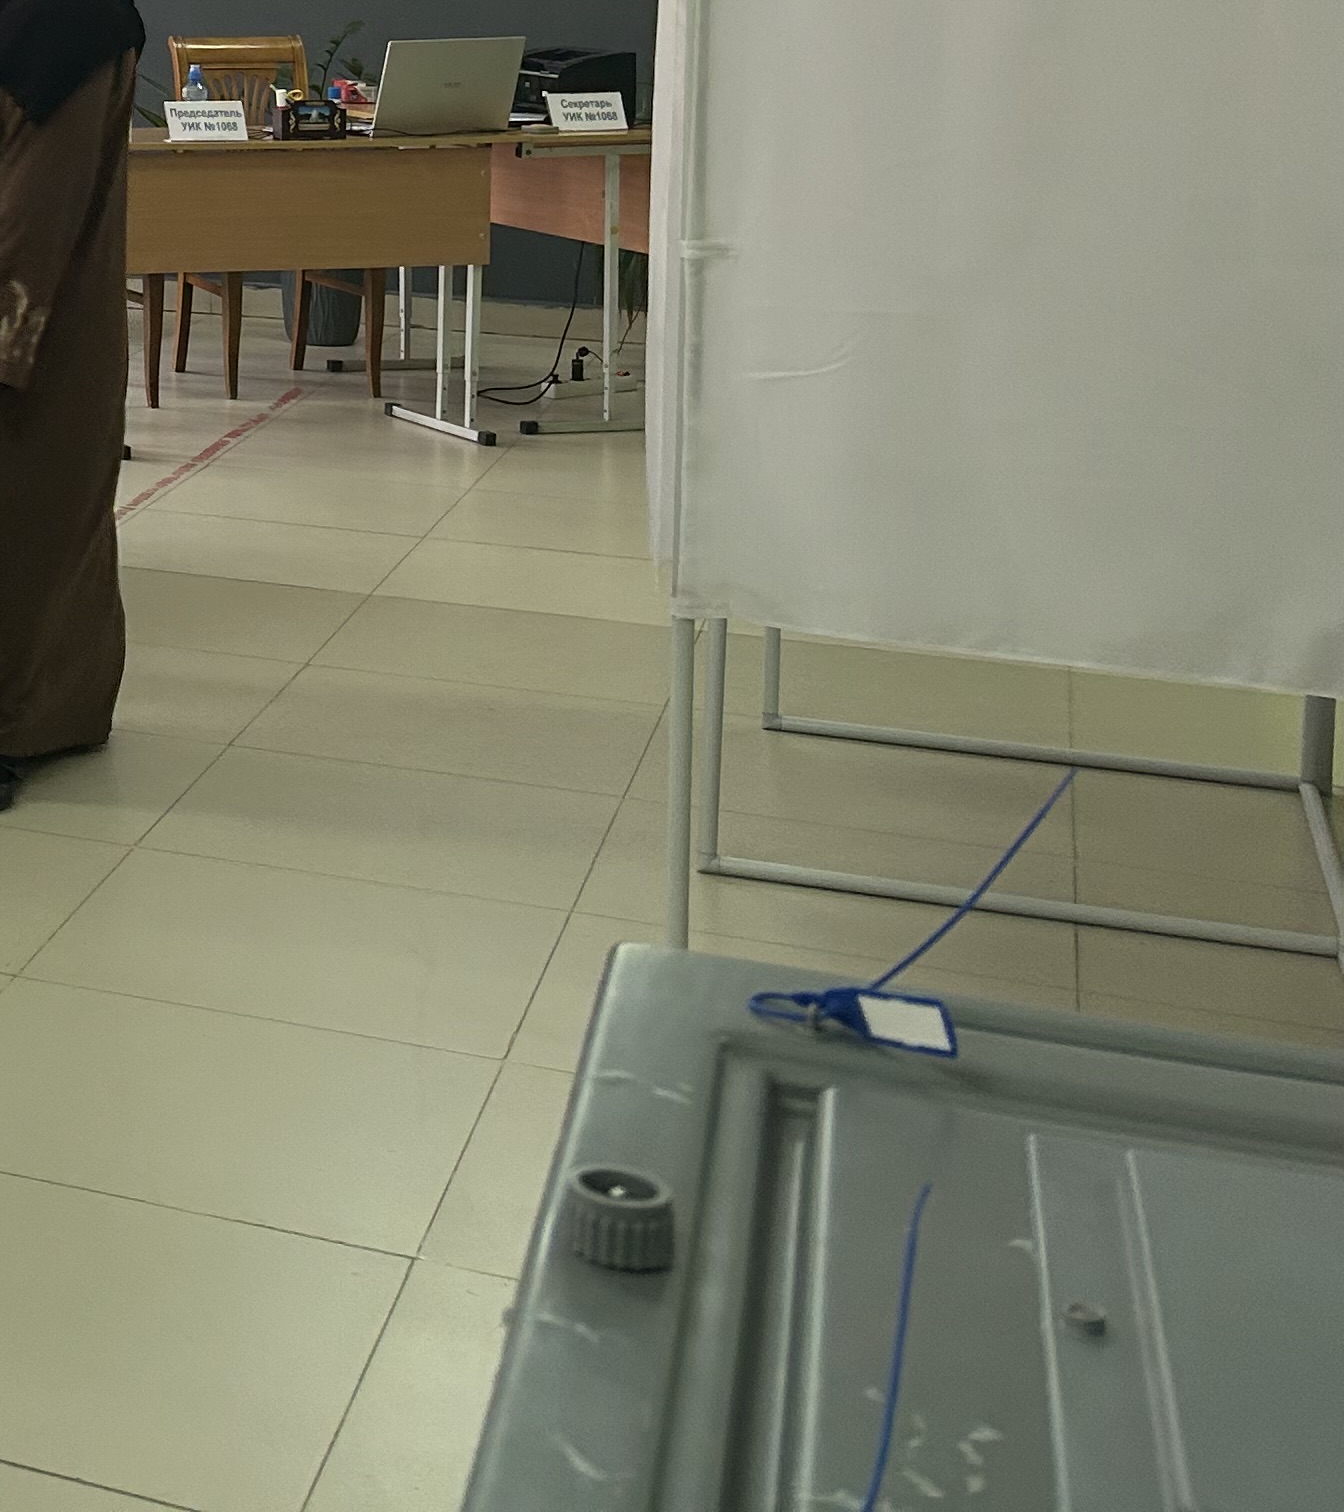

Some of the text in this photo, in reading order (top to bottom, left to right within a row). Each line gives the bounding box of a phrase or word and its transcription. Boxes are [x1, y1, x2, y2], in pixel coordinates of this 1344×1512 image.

[560, 99, 613, 110] Секретарь
[170, 108, 242, 119] Председатель
[562, 111, 618, 121] УИК №1068
[181, 122, 238, 131] УИК №1068
